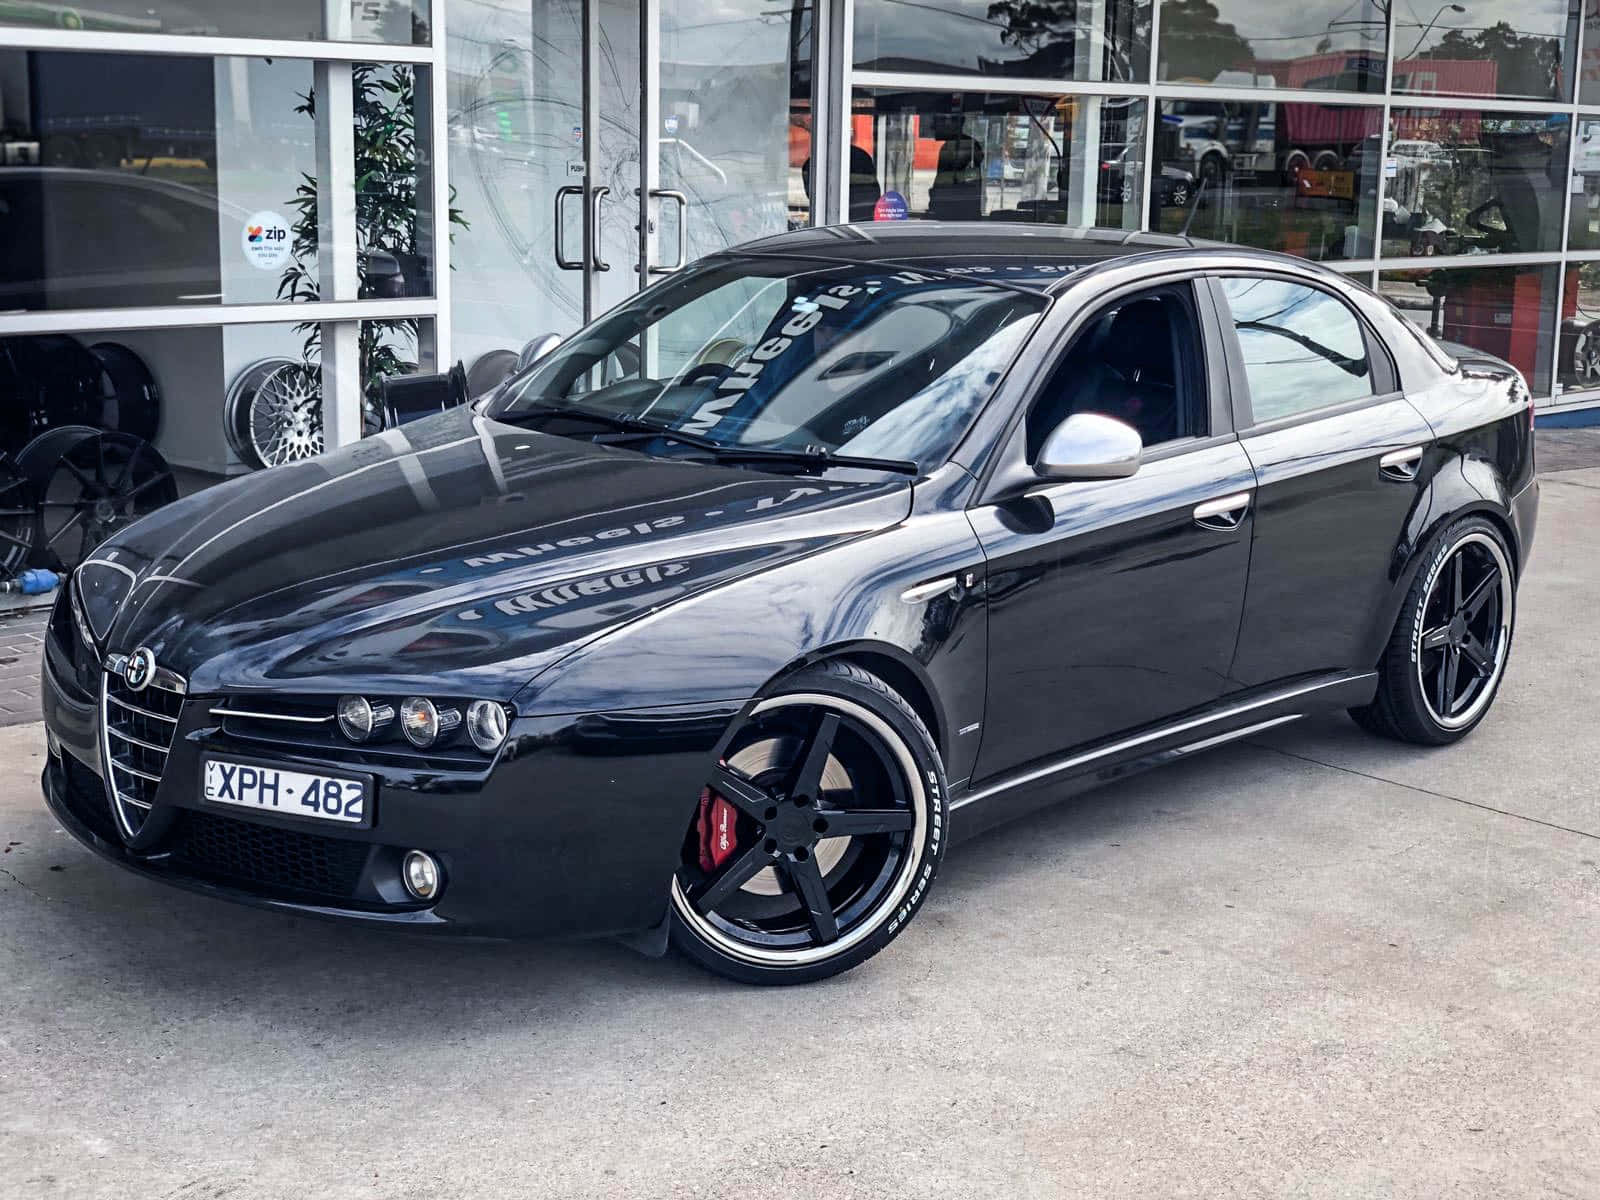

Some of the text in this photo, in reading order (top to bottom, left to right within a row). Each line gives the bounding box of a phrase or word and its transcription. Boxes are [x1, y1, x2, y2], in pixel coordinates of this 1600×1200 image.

[265, 226, 286, 242] zip
[1411, 543, 1447, 662] STREET SERIES
[206, 763, 215, 796] VIC
[218, 765, 364, 818] XPH 482
[887, 770, 942, 934] STREET SERIES
